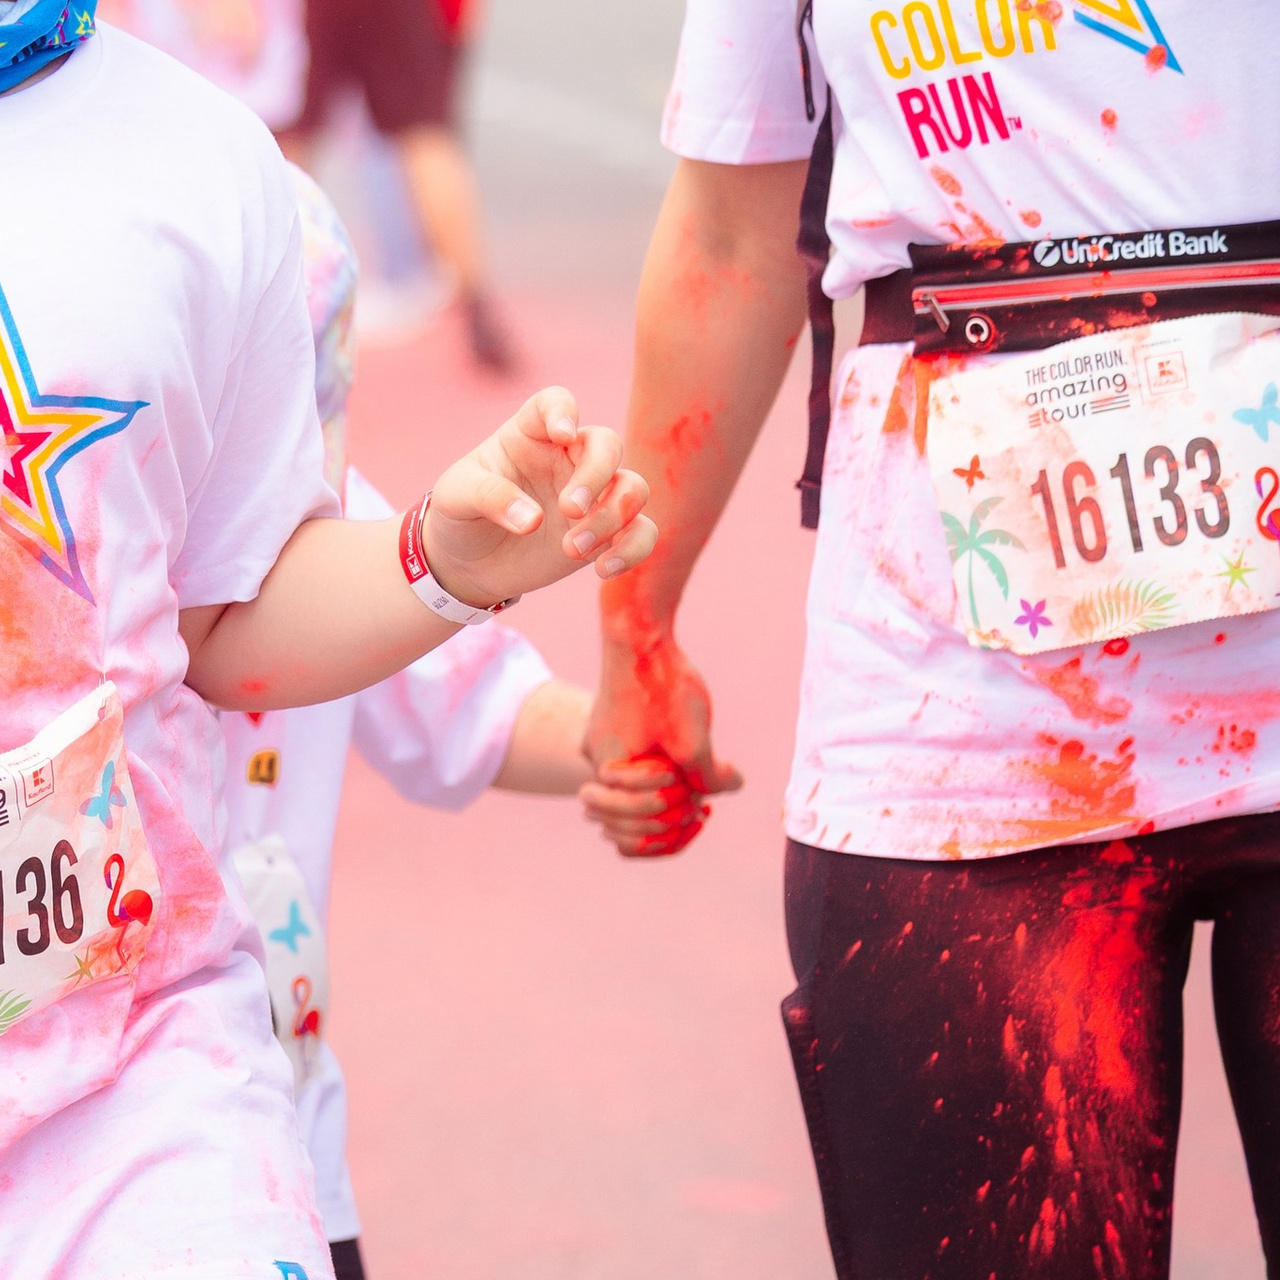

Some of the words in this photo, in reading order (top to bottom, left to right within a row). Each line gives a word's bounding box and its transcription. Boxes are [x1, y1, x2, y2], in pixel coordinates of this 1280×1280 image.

[897, 72, 1010, 160] RUN
[1061, 232, 1165, 265] UniCredit
[1168, 229, 1229, 257] Bank
[1025, 365, 1048, 387] THE
[1050, 355, 1093, 380] COLOR
[1025, 372, 1128, 407] amazing
[1041, 402, 1088, 425] tour
[1029, 436, 1231, 570] 16133
